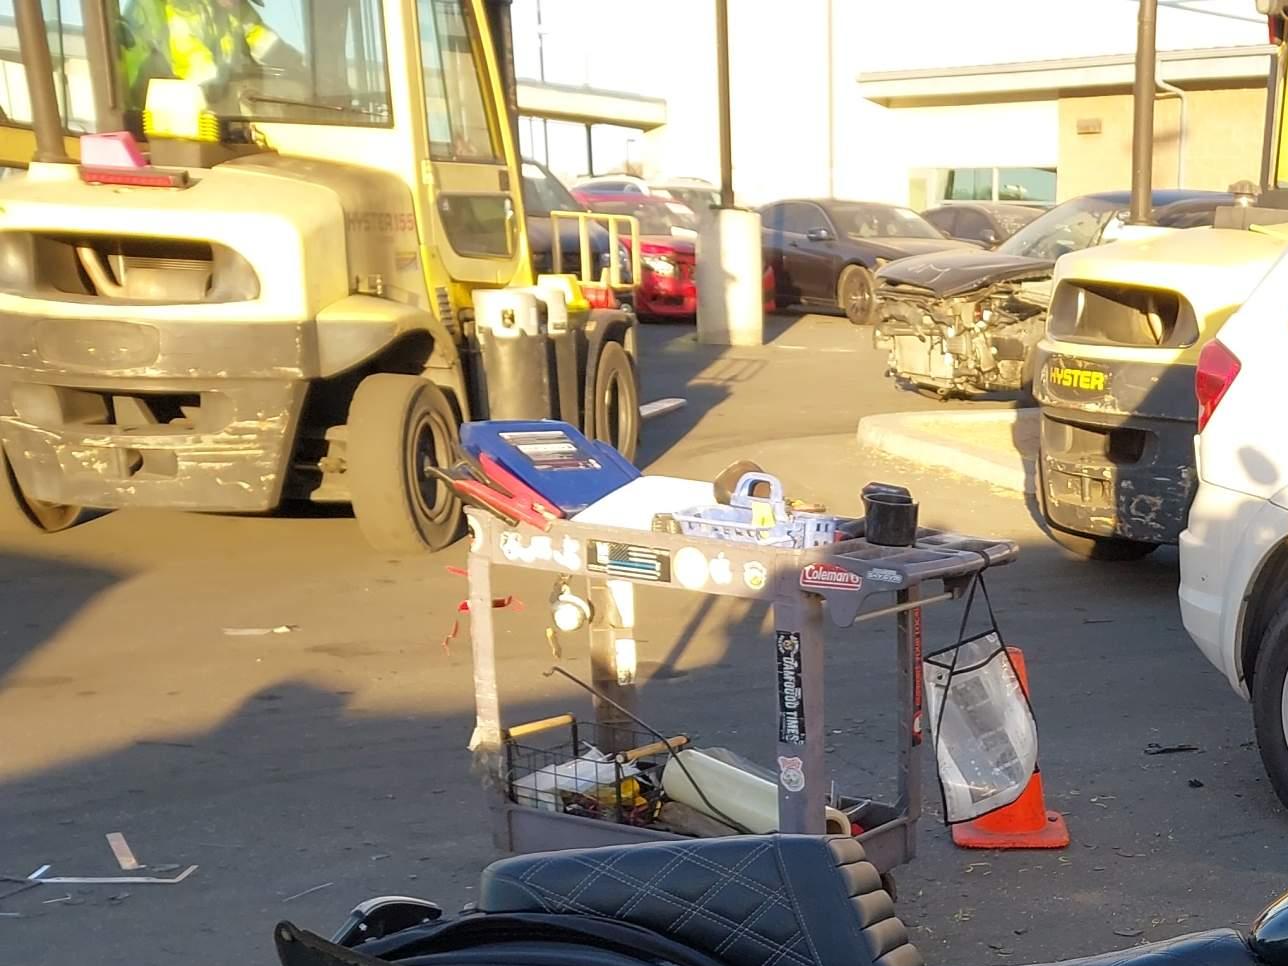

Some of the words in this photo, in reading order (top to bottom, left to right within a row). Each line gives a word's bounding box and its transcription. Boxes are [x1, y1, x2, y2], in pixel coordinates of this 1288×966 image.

[1050, 367, 1106, 391] HYSTER
[804, 564, 850, 583] Coleman
[785, 711, 801, 745] TIMES
